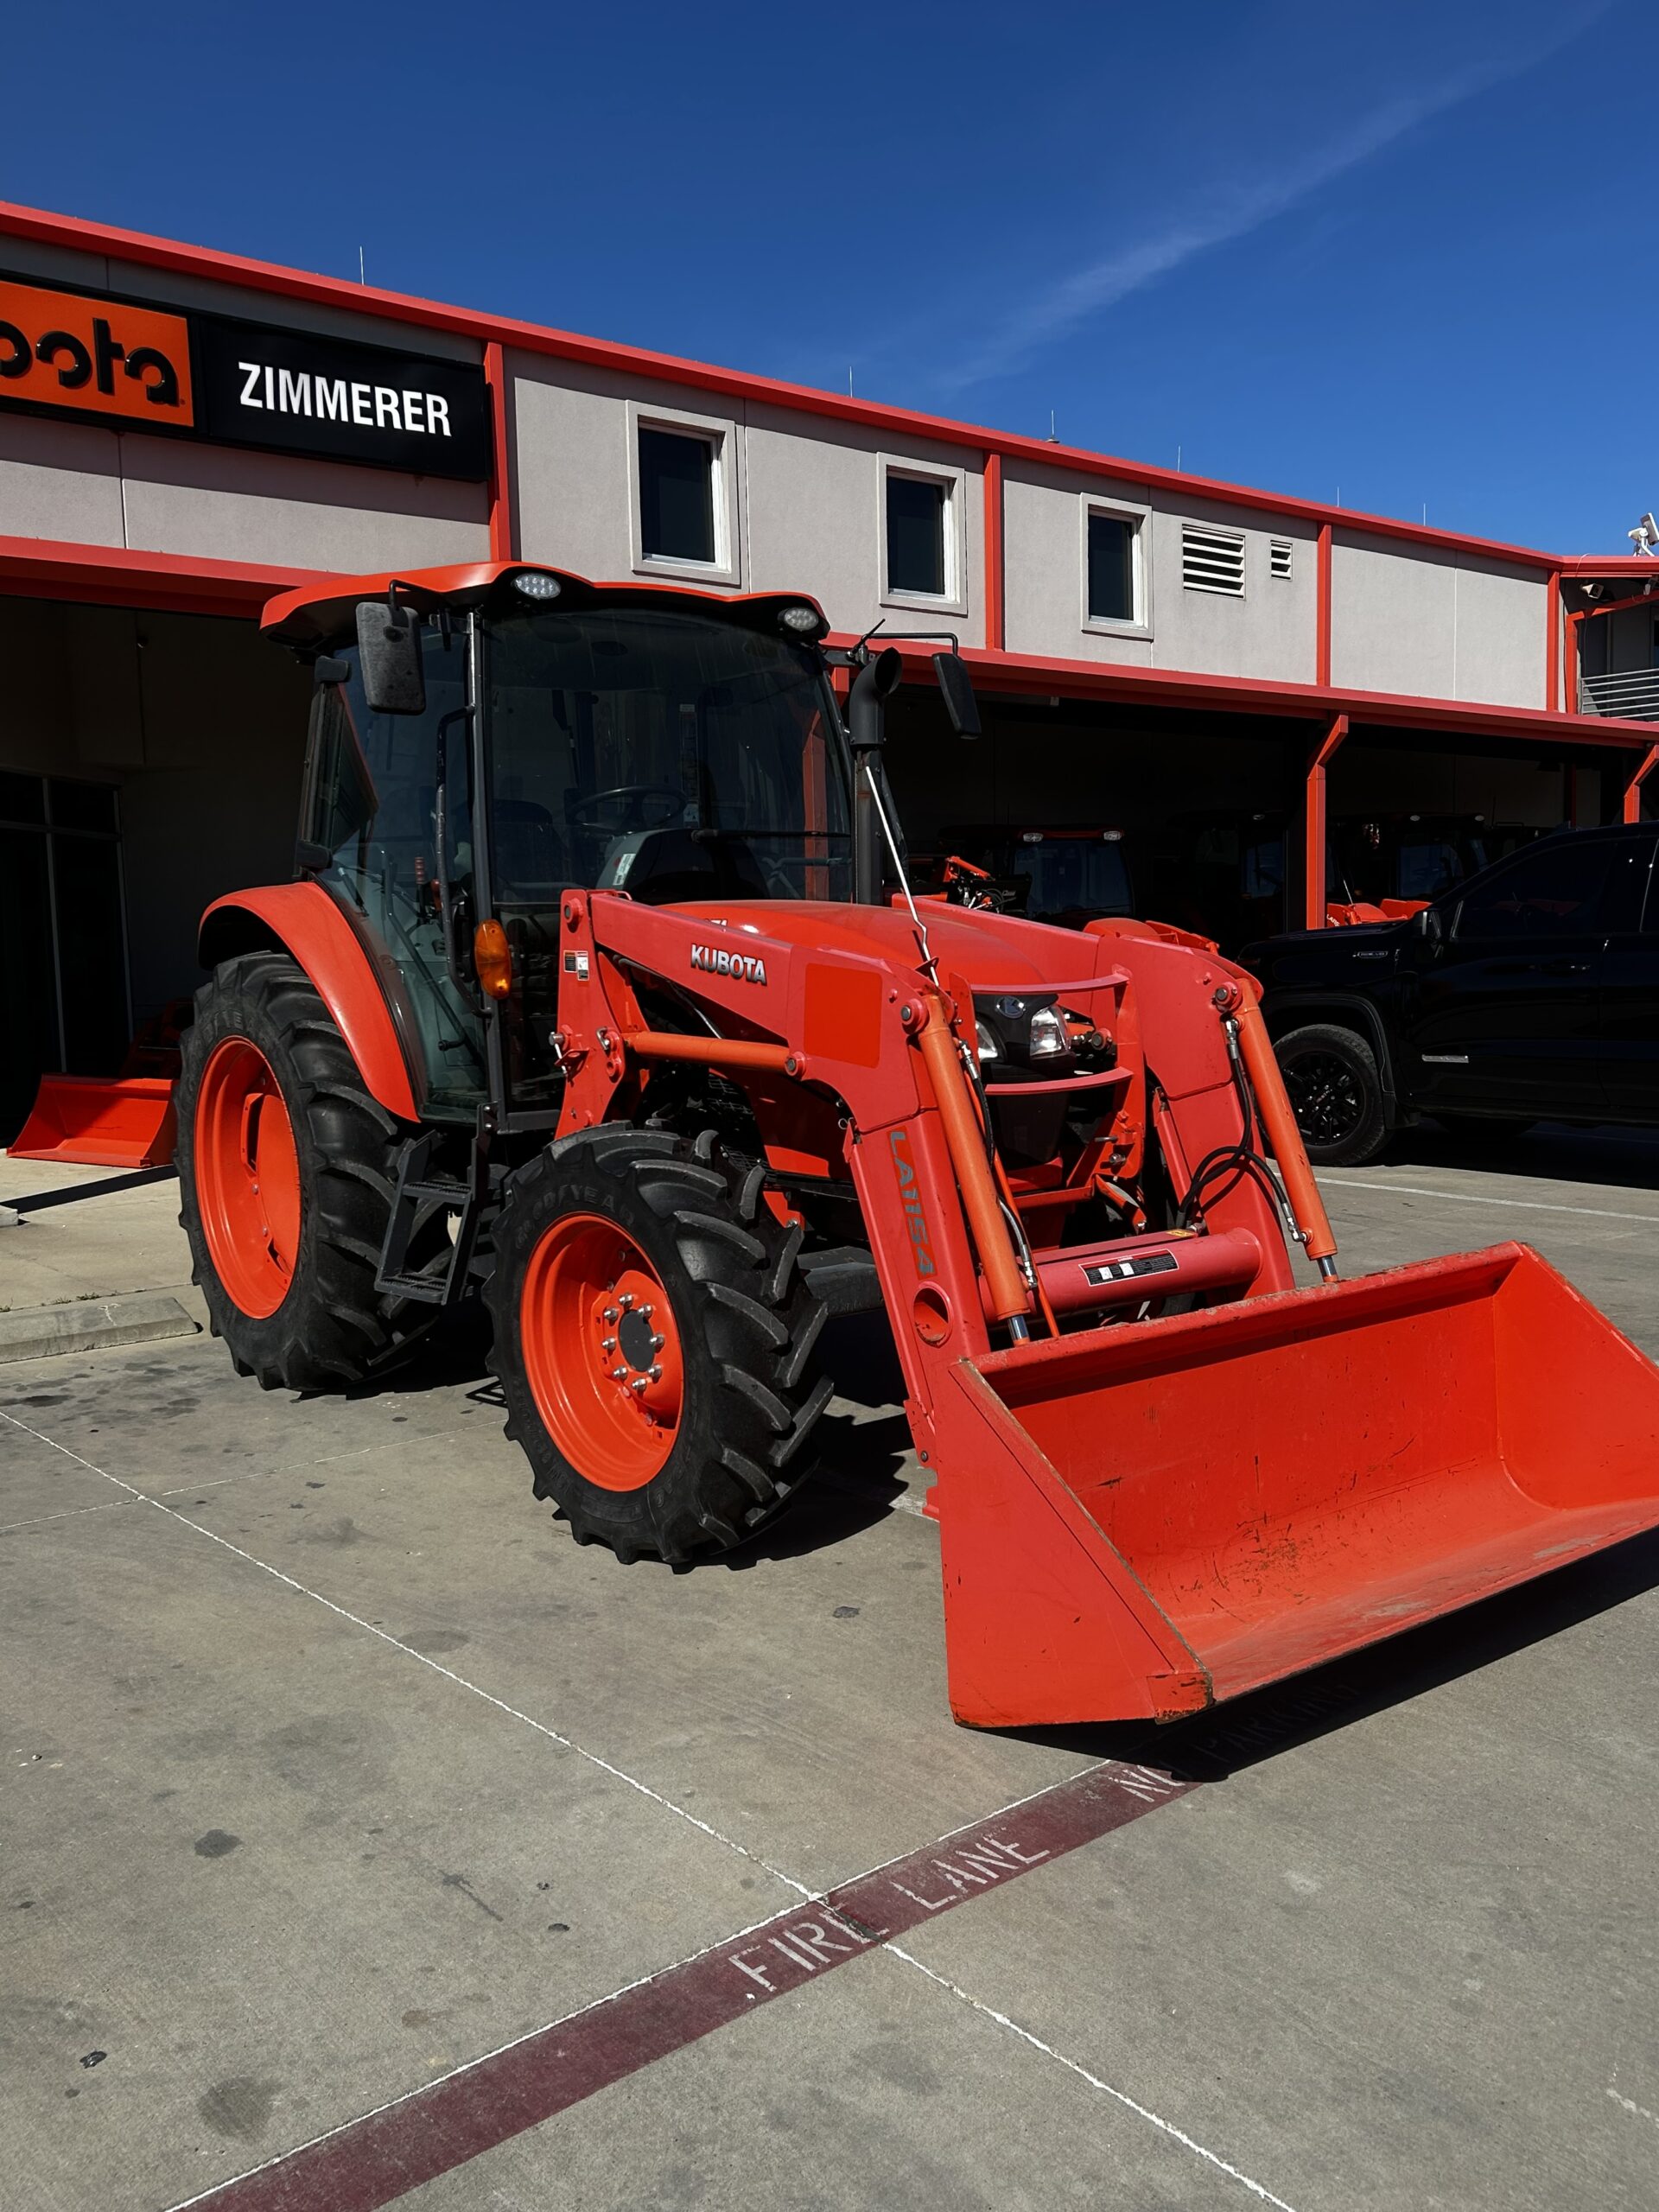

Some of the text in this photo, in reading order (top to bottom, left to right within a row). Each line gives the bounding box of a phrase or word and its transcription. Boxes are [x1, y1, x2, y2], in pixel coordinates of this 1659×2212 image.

[238, 361, 452, 436] ZIMMERER
[691, 943, 767, 986] KUBOTA
[890, 1131, 935, 1276] LA1154
[728, 1903, 889, 1992] FIRE
[889, 1826, 1051, 1910] LANE
